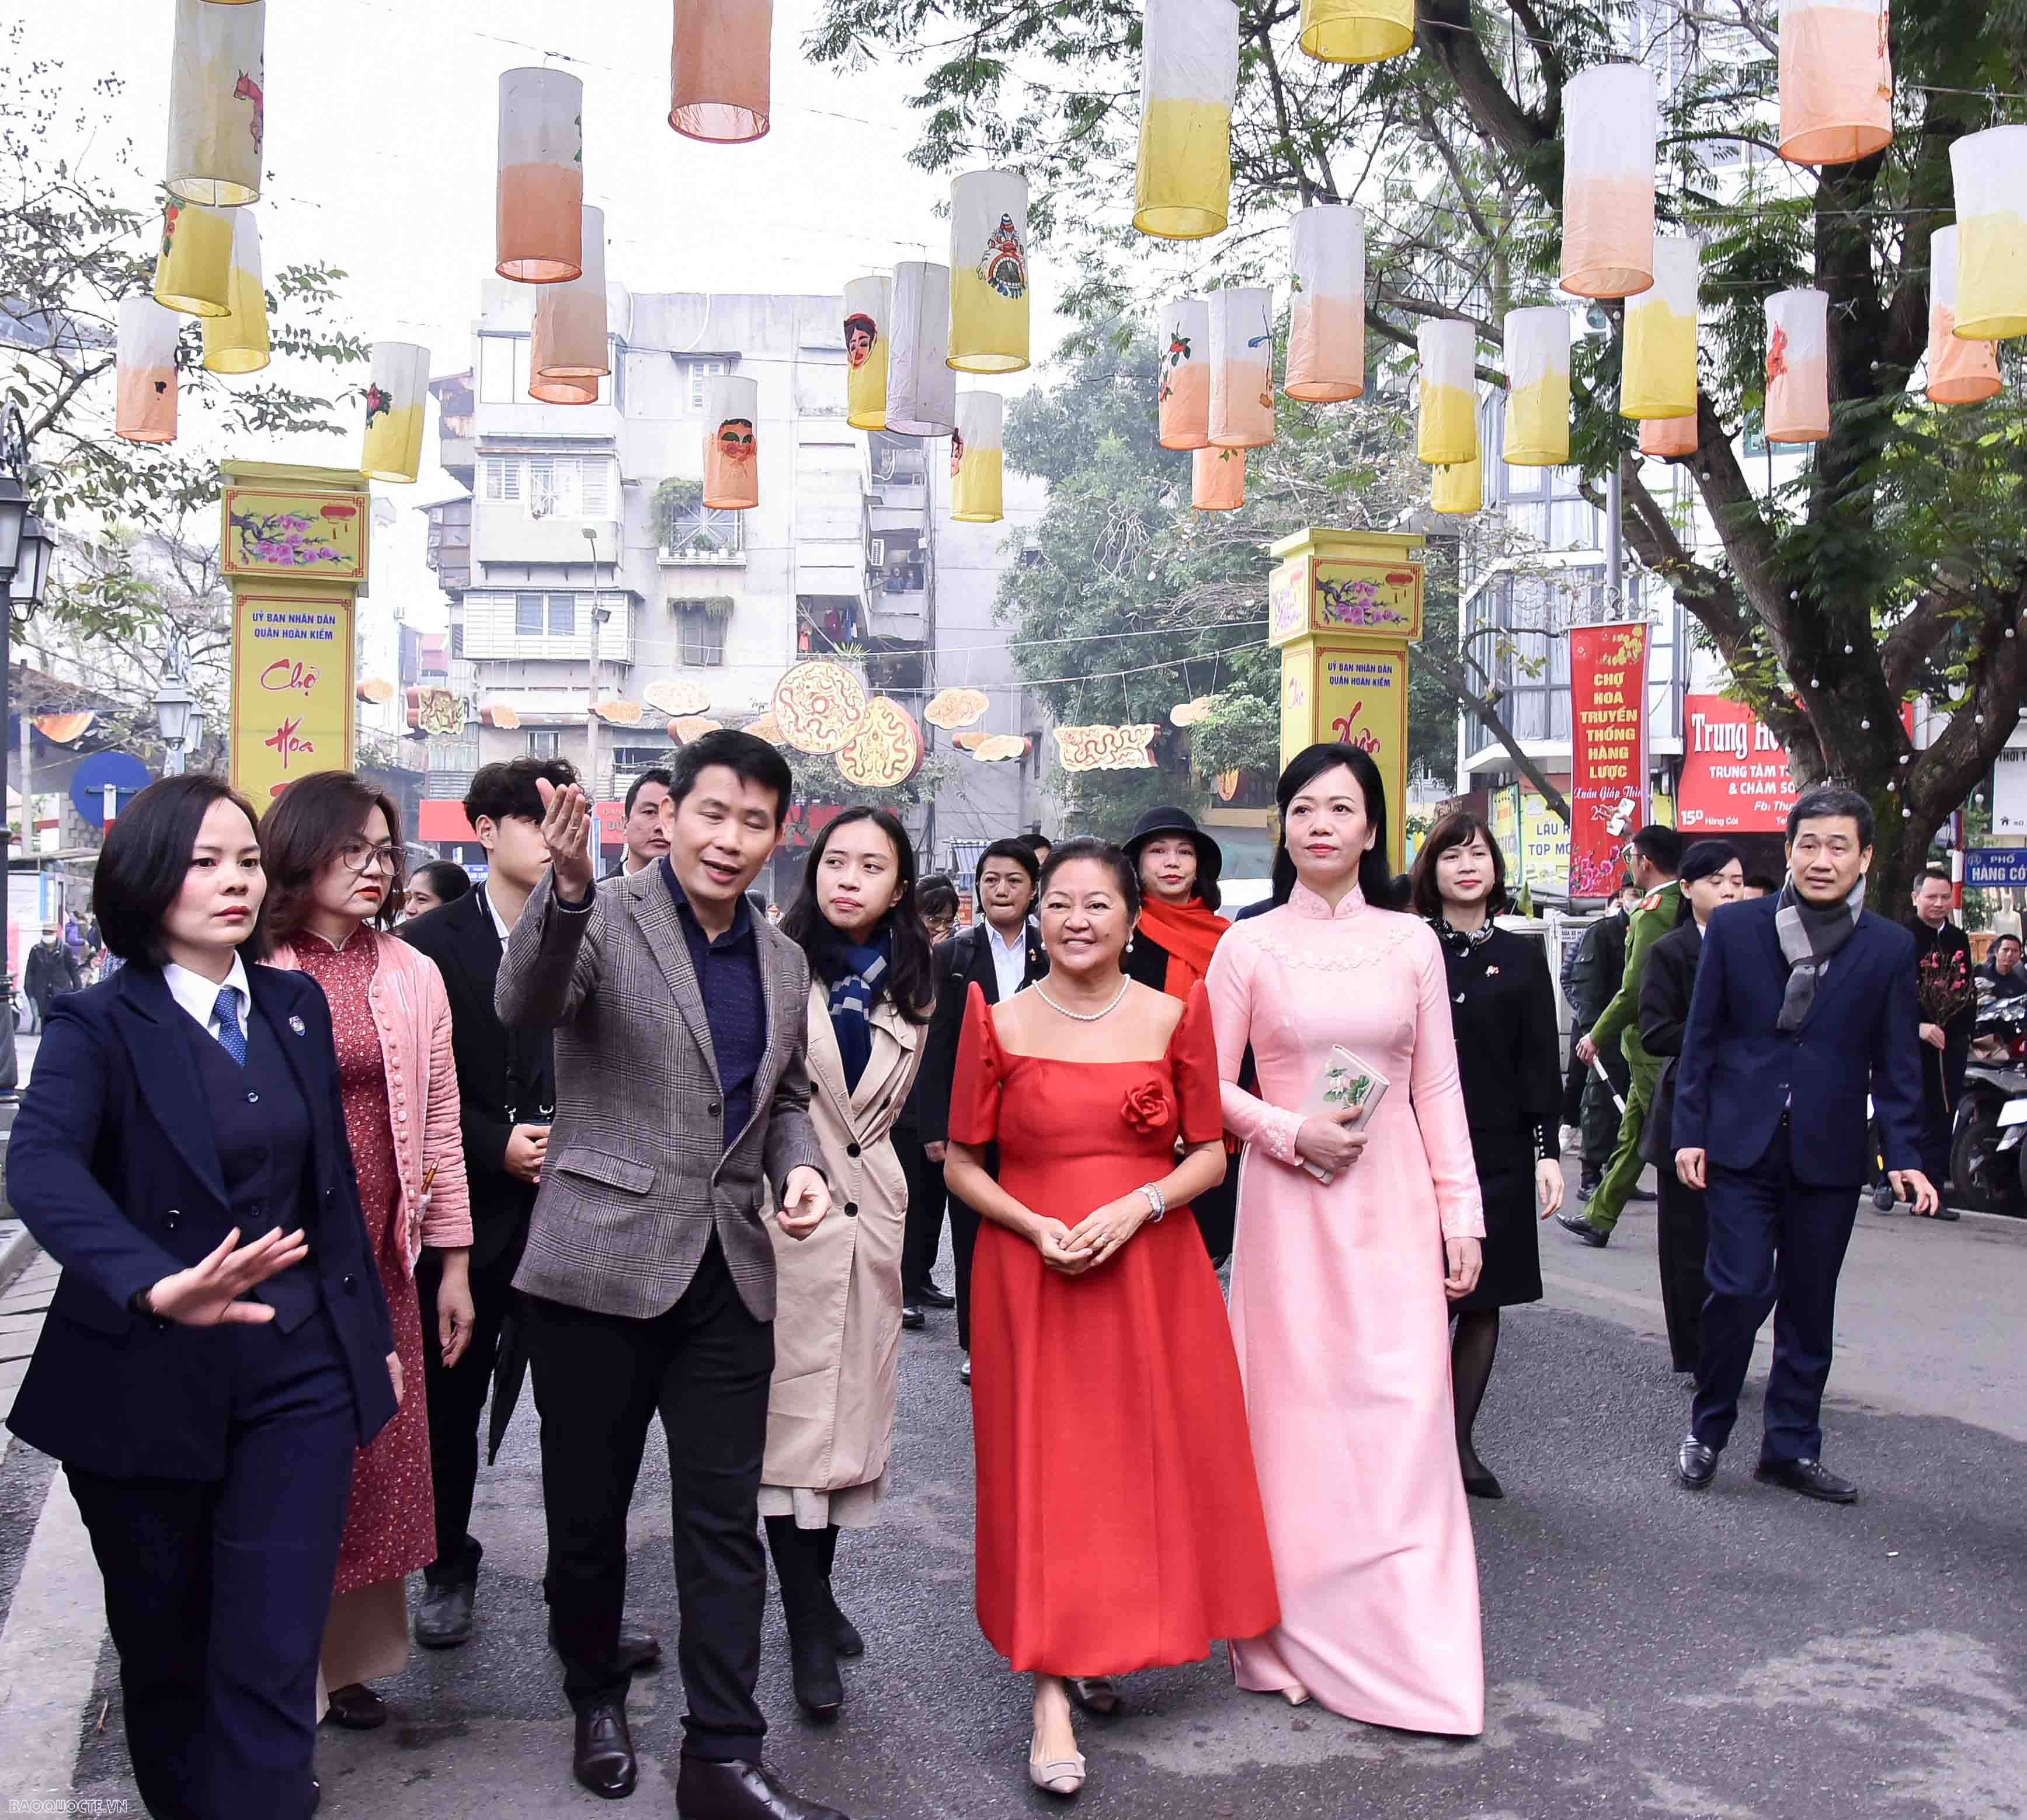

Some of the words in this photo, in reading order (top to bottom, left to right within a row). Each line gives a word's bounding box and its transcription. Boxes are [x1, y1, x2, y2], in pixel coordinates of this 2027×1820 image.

[267, 613, 286, 623] BAN
[289, 613, 314, 624] NHÂN
[317, 614, 335, 624] DÂN
[1339, 663, 1353, 672] BAN
[260, 658, 321, 696] Chợ
[1594, 671, 1625, 688] CHỢ
[1594, 691, 1624, 705] HOA
[1586, 725, 1635, 742] THỐNG
[1691, 713, 1748, 760] Trung
[265, 716, 314, 768] Hoa
[1588, 745, 1629, 760] HÀNG
[1590, 765, 1628, 780] LƯỢC
[1709, 765, 1747, 778] TRUNG
[1750, 763, 1776, 778] TÂM
[1728, 782, 1737, 795] &
[1990, 852, 2016, 864] PHỐ
[1972, 864, 2006, 882] HÀNG
[2009, 864, 2027, 882] CÓ
